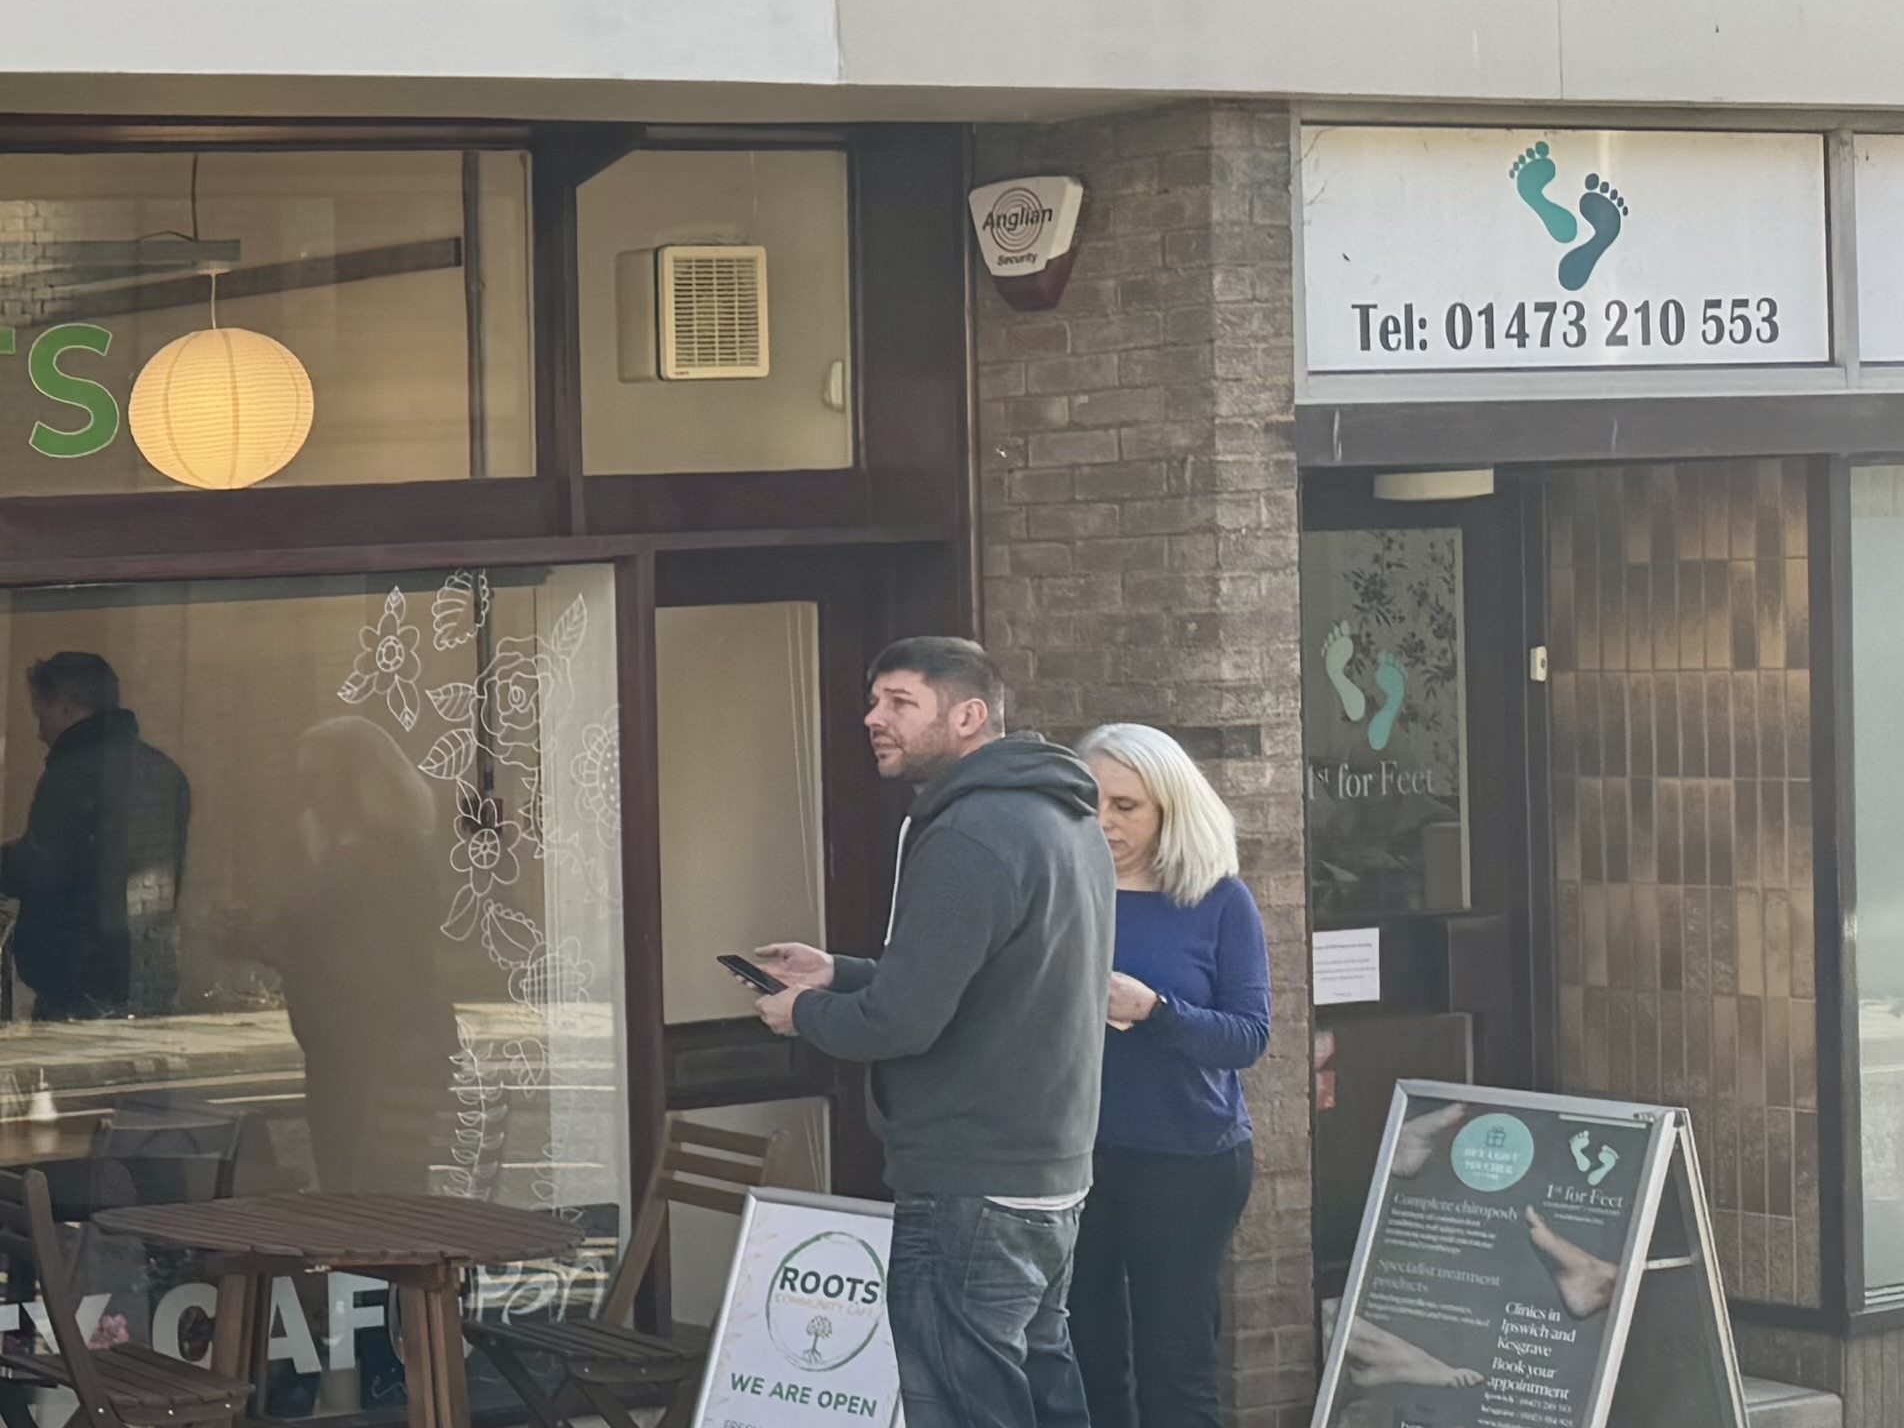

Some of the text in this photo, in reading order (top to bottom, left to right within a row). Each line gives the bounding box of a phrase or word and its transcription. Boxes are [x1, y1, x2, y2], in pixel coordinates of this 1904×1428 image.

[981, 206, 1054, 232] Anglian
[996, 252, 1039, 267] Security
[1350, 296, 1781, 352] Tel: 01473 210 553
[1338, 762, 1374, 799] for
[1379, 759, 1433, 796] Feet
[1393, 1192, 1454, 1212] Complete
[1455, 1199, 1518, 1221] chiropody
[1564, 1185, 1589, 1204] for
[1588, 1188, 1624, 1209] Feet
[778, 1265, 881, 1305] ROOTS
[1372, 1275, 1430, 1292] products
[1437, 1266, 1501, 1287] treatment
[150, 1270, 474, 1375] CAF
[1504, 1301, 1547, 1320] Clinics
[1548, 1307, 1561, 1322] in
[1501, 1318, 1577, 1343] Ipswich and
[1496, 1335, 1553, 1357] Kesgrave
[1491, 1356, 1559, 1379] Book your
[730, 1372, 878, 1418] WE ARE OPEN
[1486, 1376, 1570, 1401] appointment
